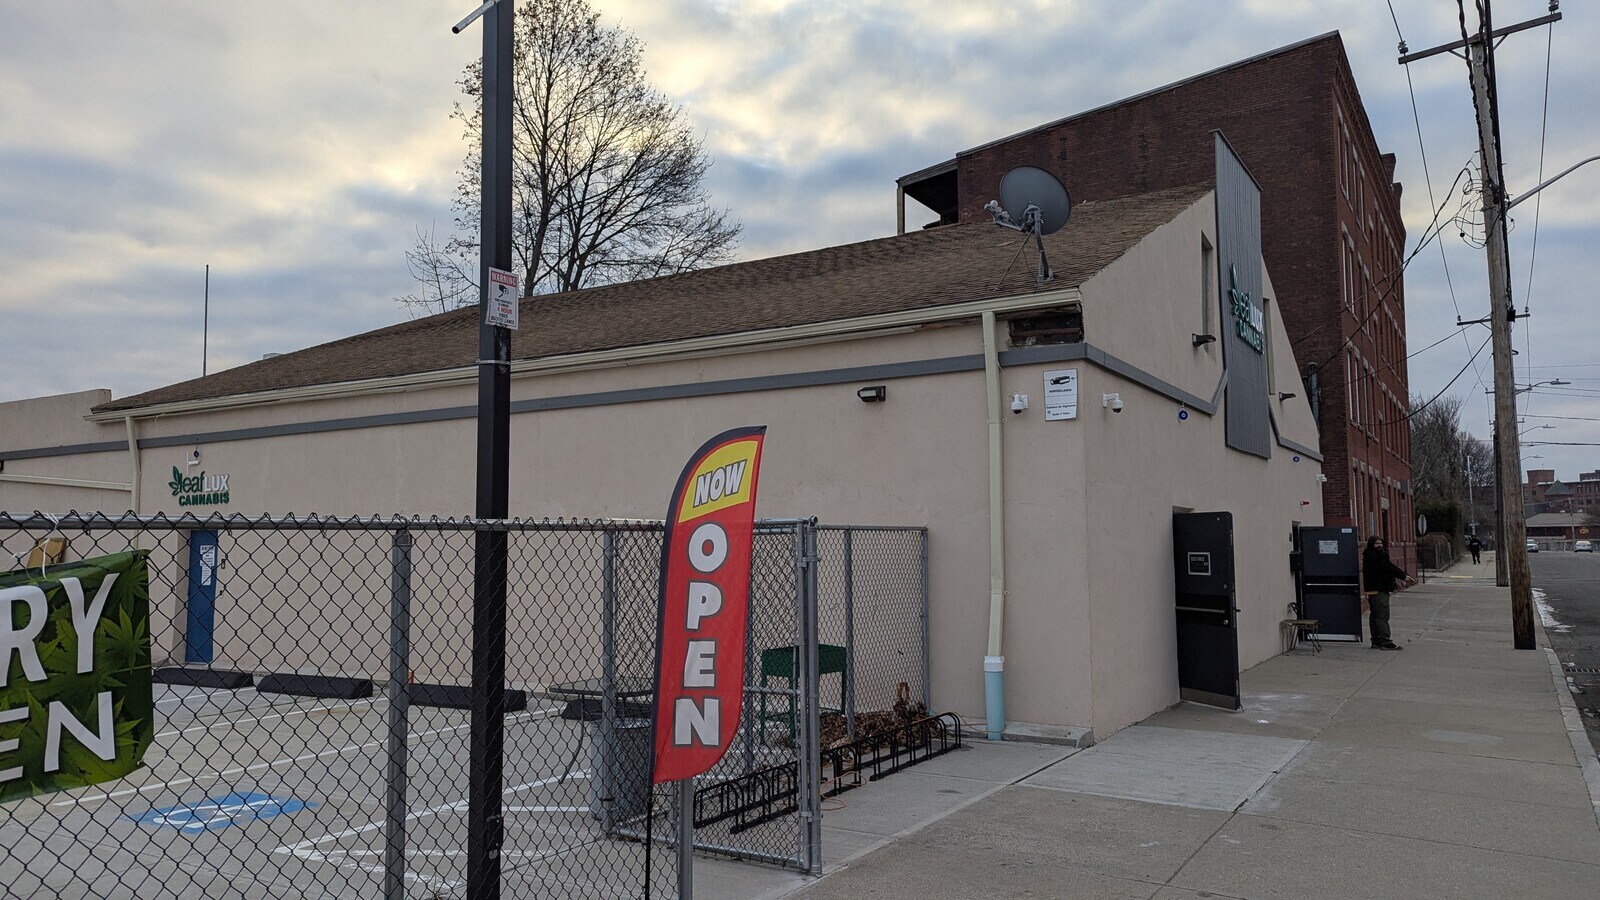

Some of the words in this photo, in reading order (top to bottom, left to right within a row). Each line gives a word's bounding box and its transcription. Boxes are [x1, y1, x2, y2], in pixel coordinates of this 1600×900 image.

[492, 272, 516, 286] WARNING
[179, 491, 230, 507] CANNABIS
[693, 459, 747, 508] NOW
[673, 523, 729, 746] OPEN
